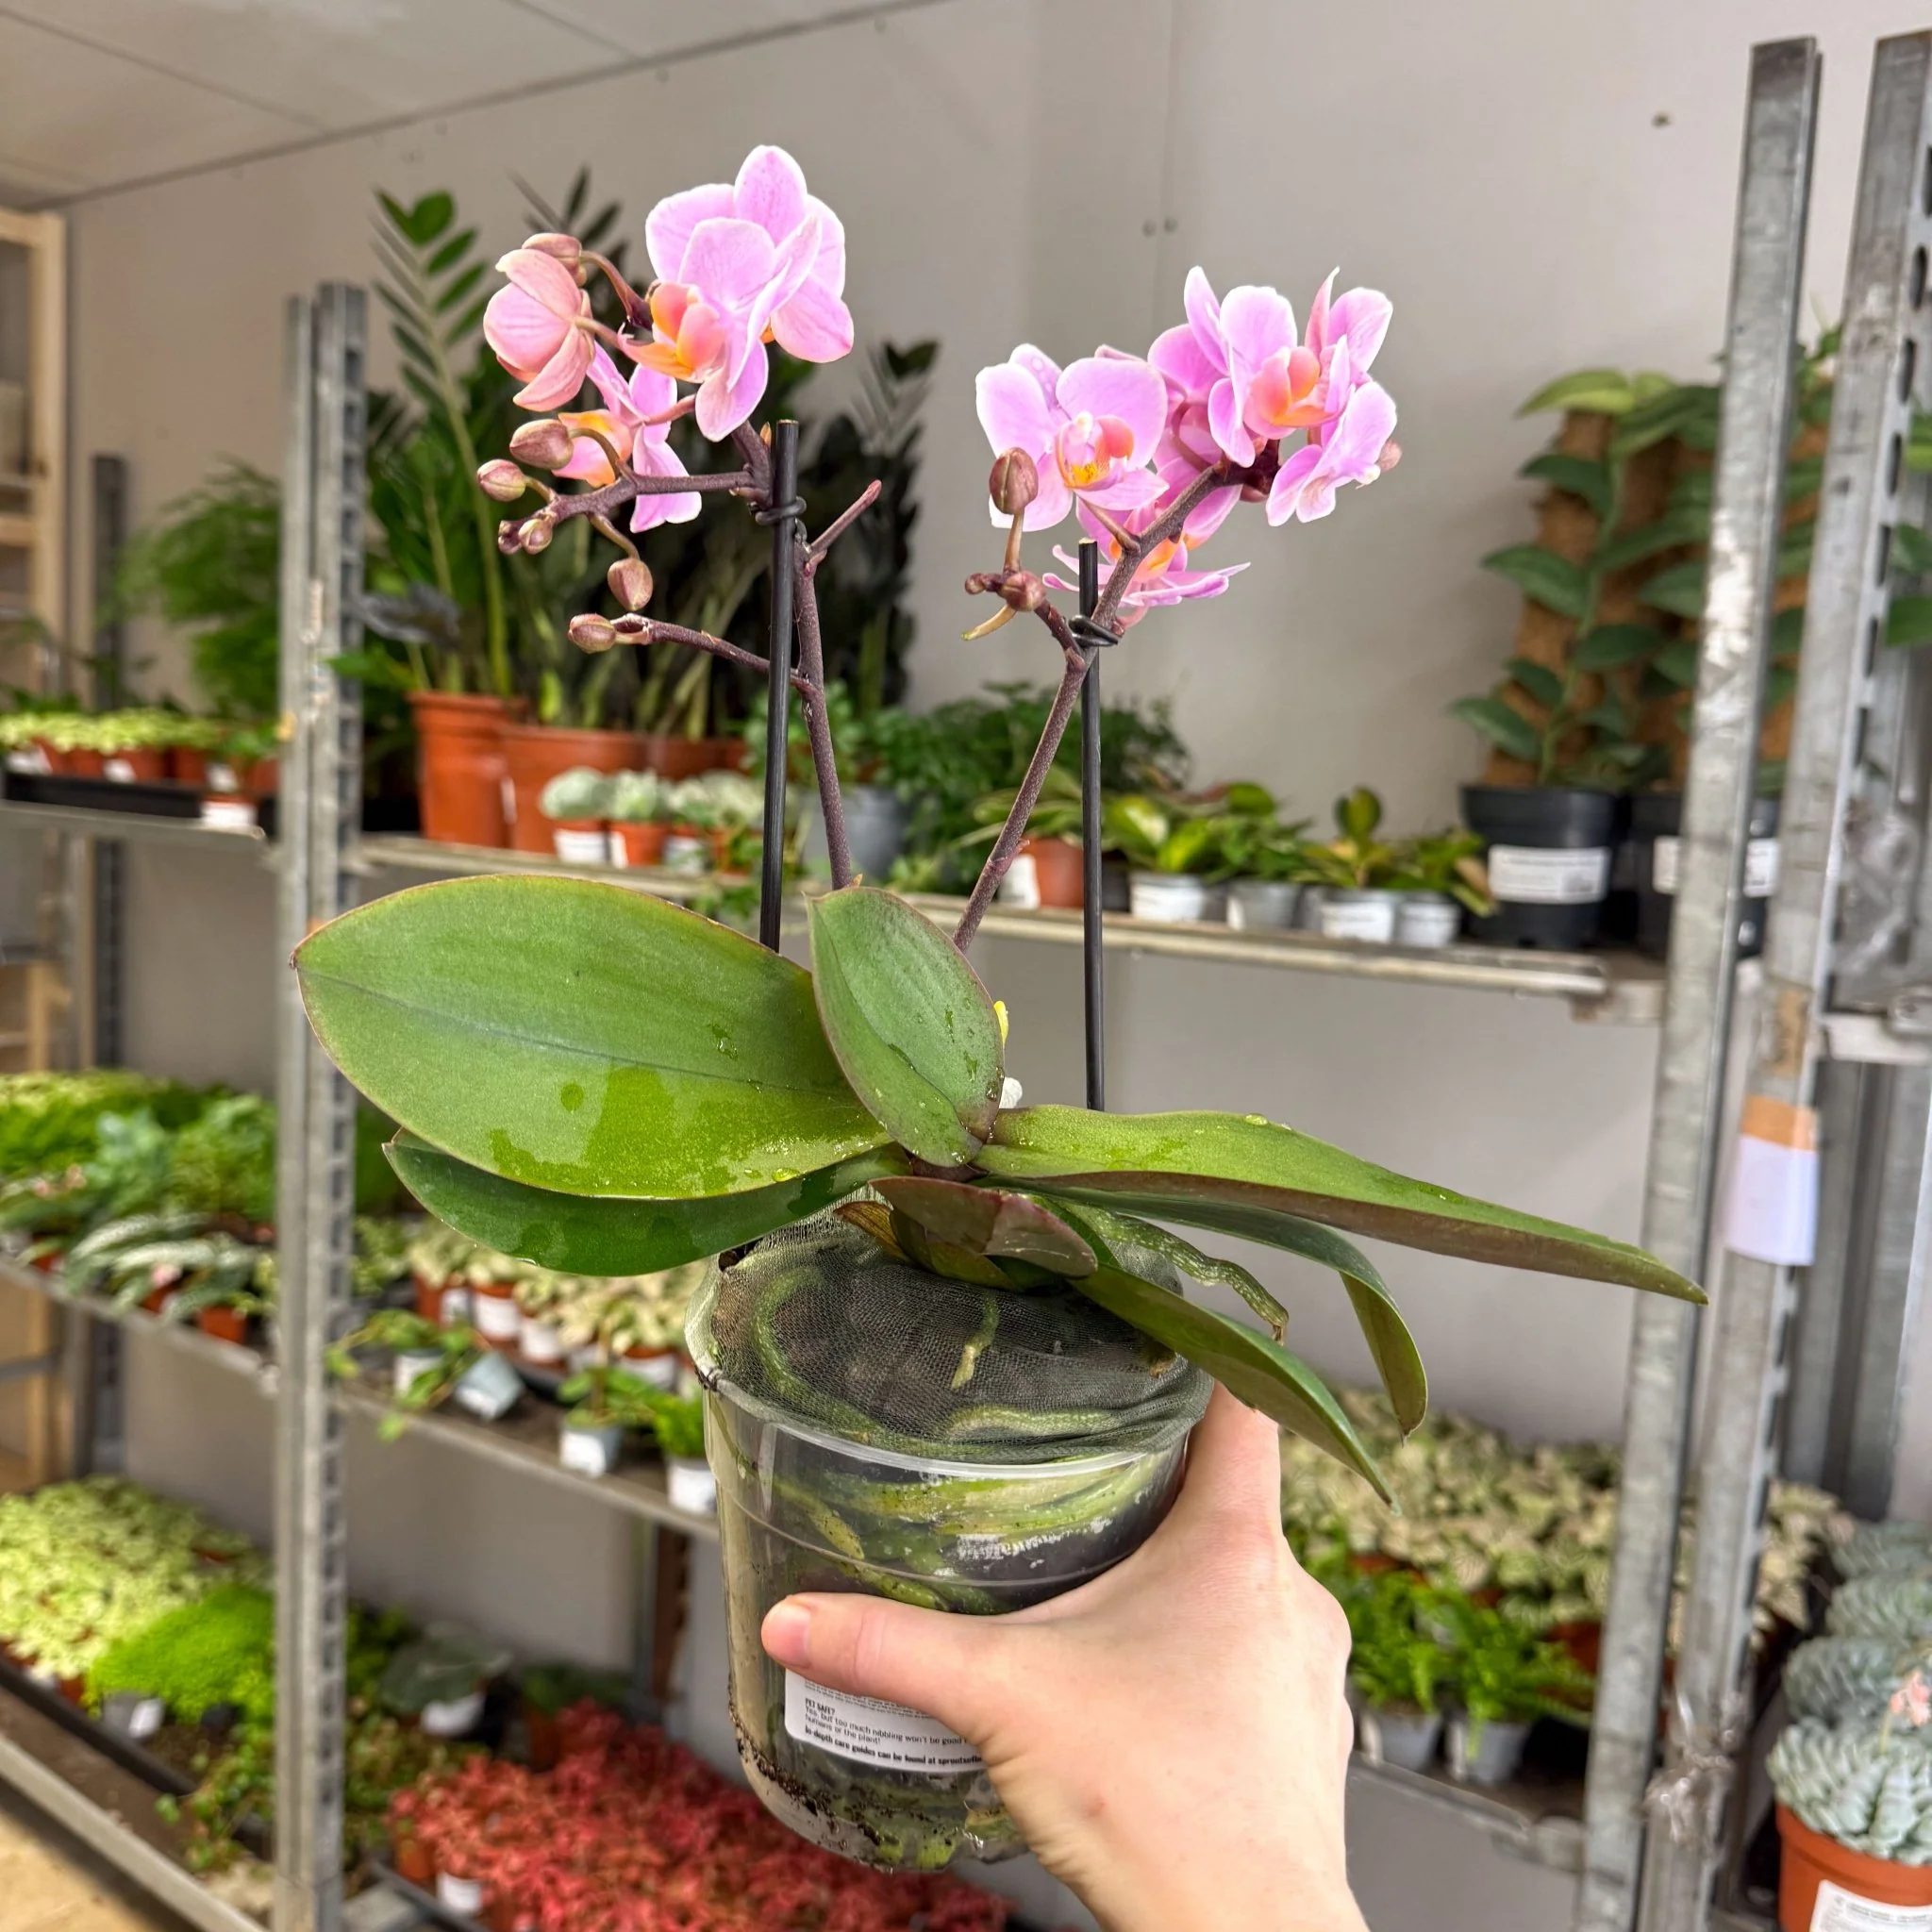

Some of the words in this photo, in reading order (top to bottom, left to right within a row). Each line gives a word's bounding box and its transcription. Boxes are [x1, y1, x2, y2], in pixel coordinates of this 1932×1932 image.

[821, 1712, 833, 1723] but
[835, 1717, 848, 1727] too
[849, 1724, 871, 1734] much
[873, 1728, 903, 1741] nibbling
[929, 1736, 941, 1744] be
[942, 1738, 962, 1746] good
[834, 1725, 841, 1734] or
[844, 1728, 857, 1739] the
[858, 1734, 881, 1744] plant!
[835, 1739, 850, 1749] care
[852, 1744, 875, 1757] guides
[877, 1751, 891, 1759] can
[892, 1752, 902, 1760] be
[905, 1754, 926, 1764] found
[928, 1756, 936, 1764] at
